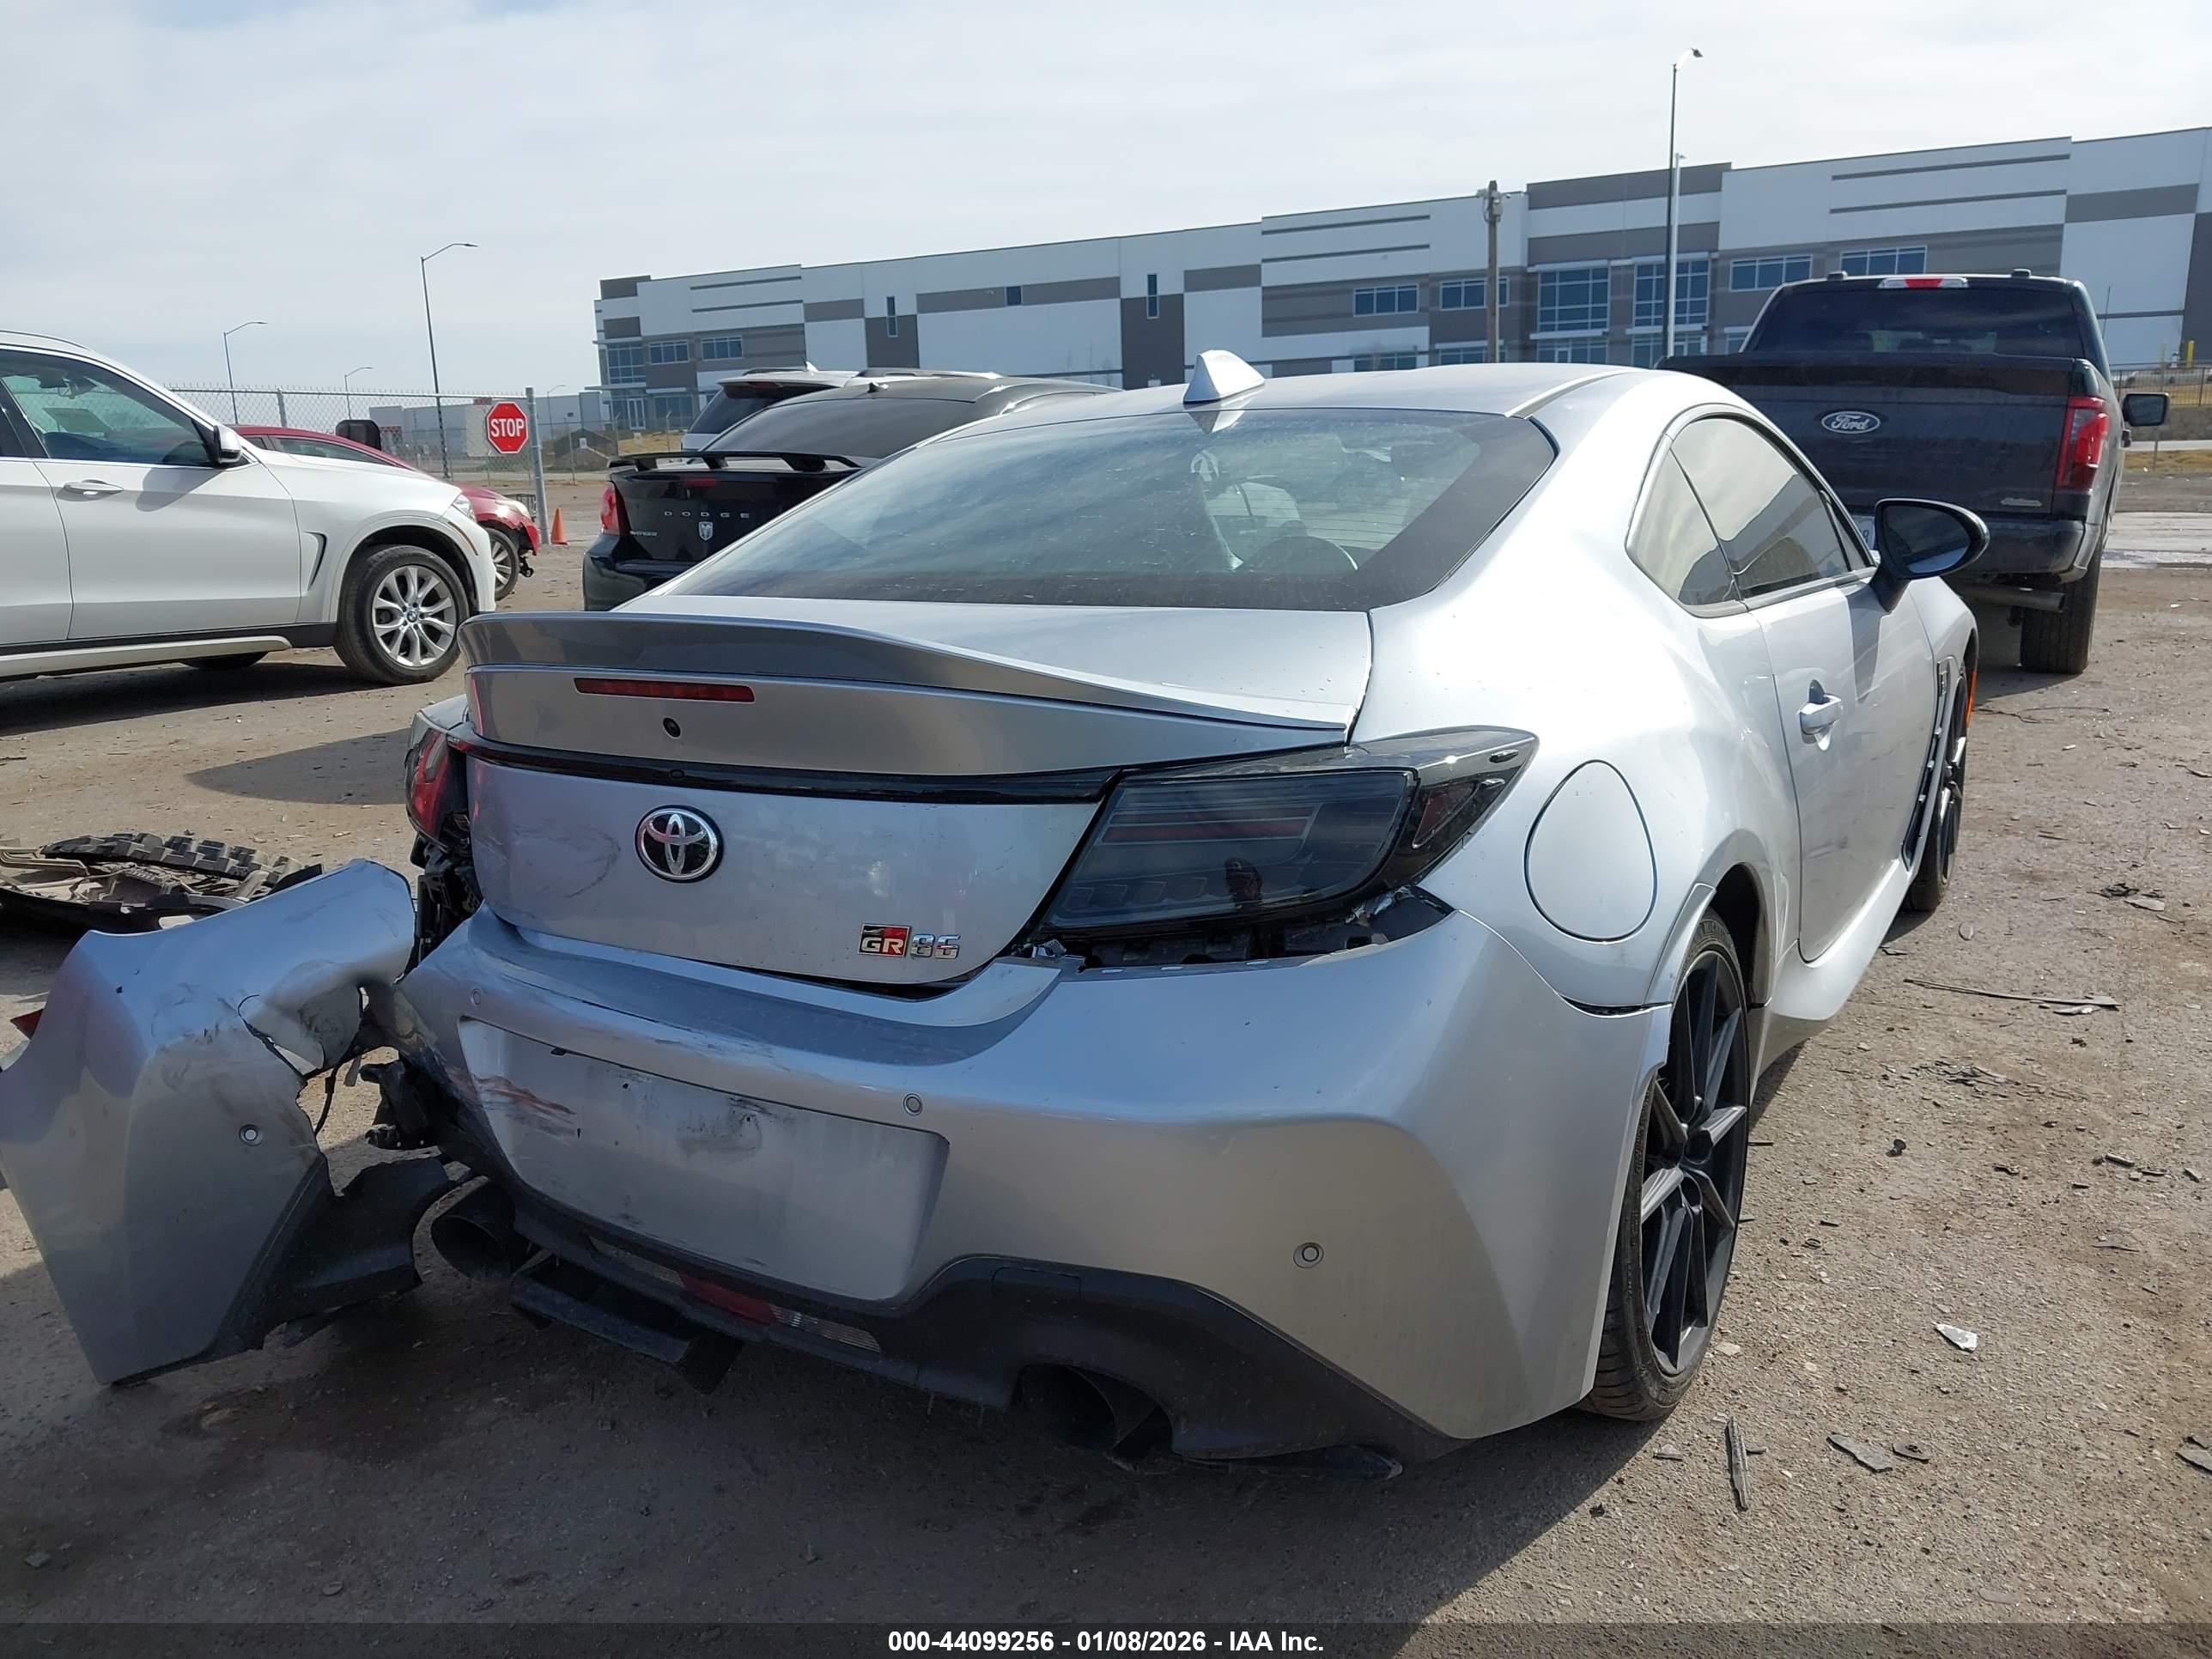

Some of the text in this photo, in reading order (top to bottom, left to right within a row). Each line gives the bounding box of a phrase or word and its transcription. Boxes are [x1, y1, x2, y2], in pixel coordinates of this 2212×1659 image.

[490, 418, 525, 437] STOP
[1831, 414, 1871, 430] Ford
[860, 933, 961, 959] GR 86
